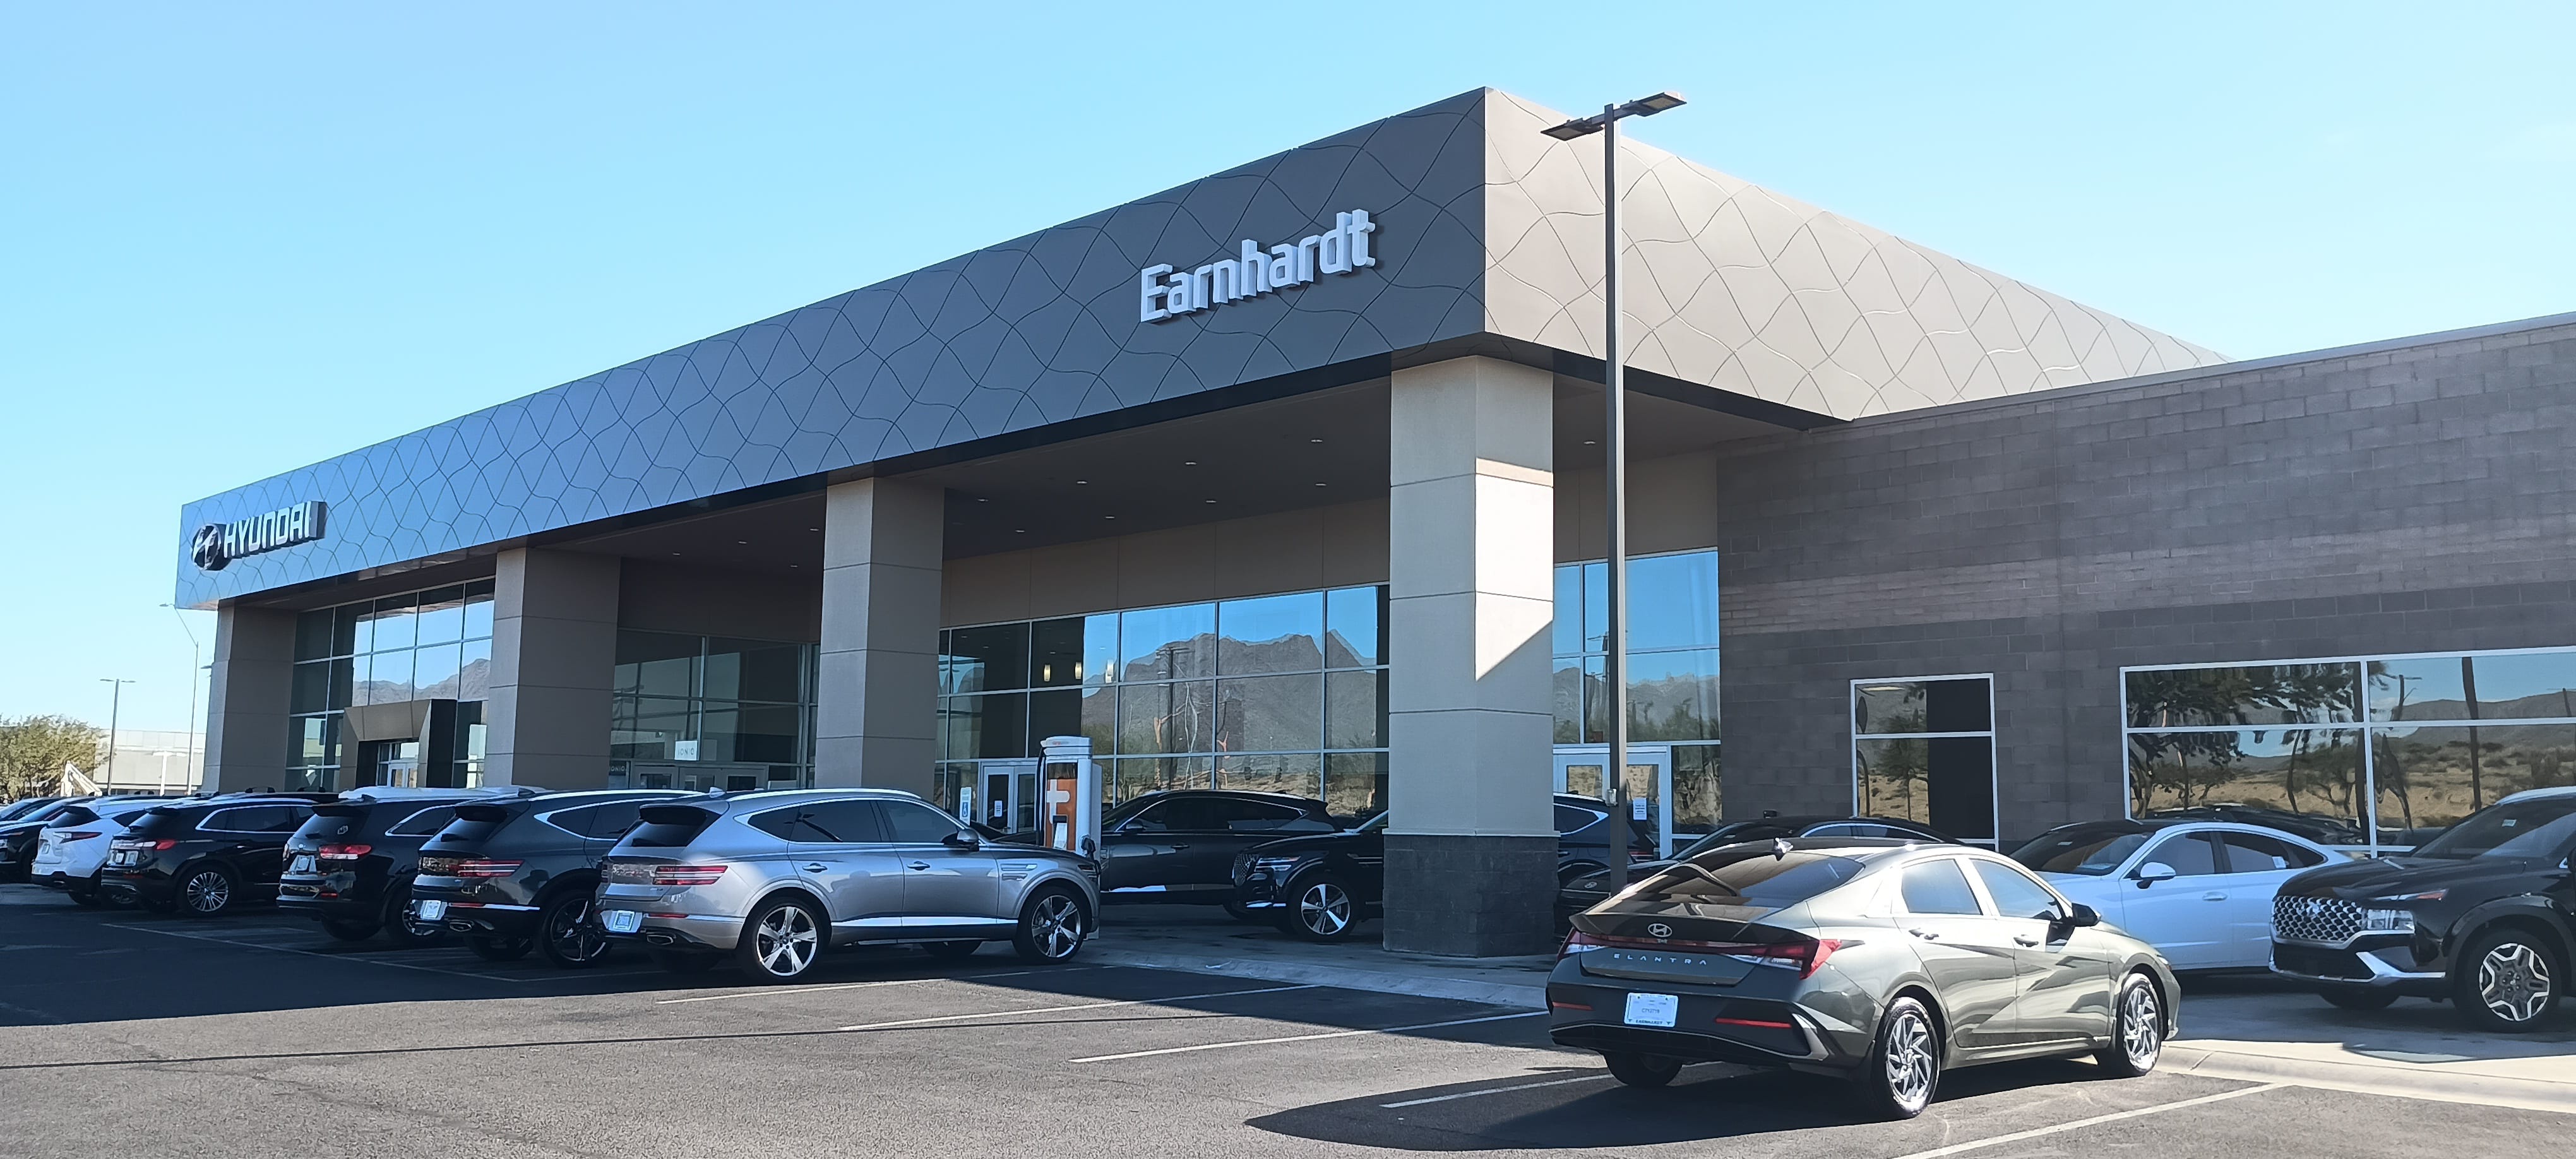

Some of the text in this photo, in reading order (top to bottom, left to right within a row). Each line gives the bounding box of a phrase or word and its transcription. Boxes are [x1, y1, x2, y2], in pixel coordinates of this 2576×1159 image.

[1140, 209, 1375, 322] Earnhardt
[224, 501, 316, 558] HYUNDAI
[1614, 953, 1707, 965] ELANTRA
